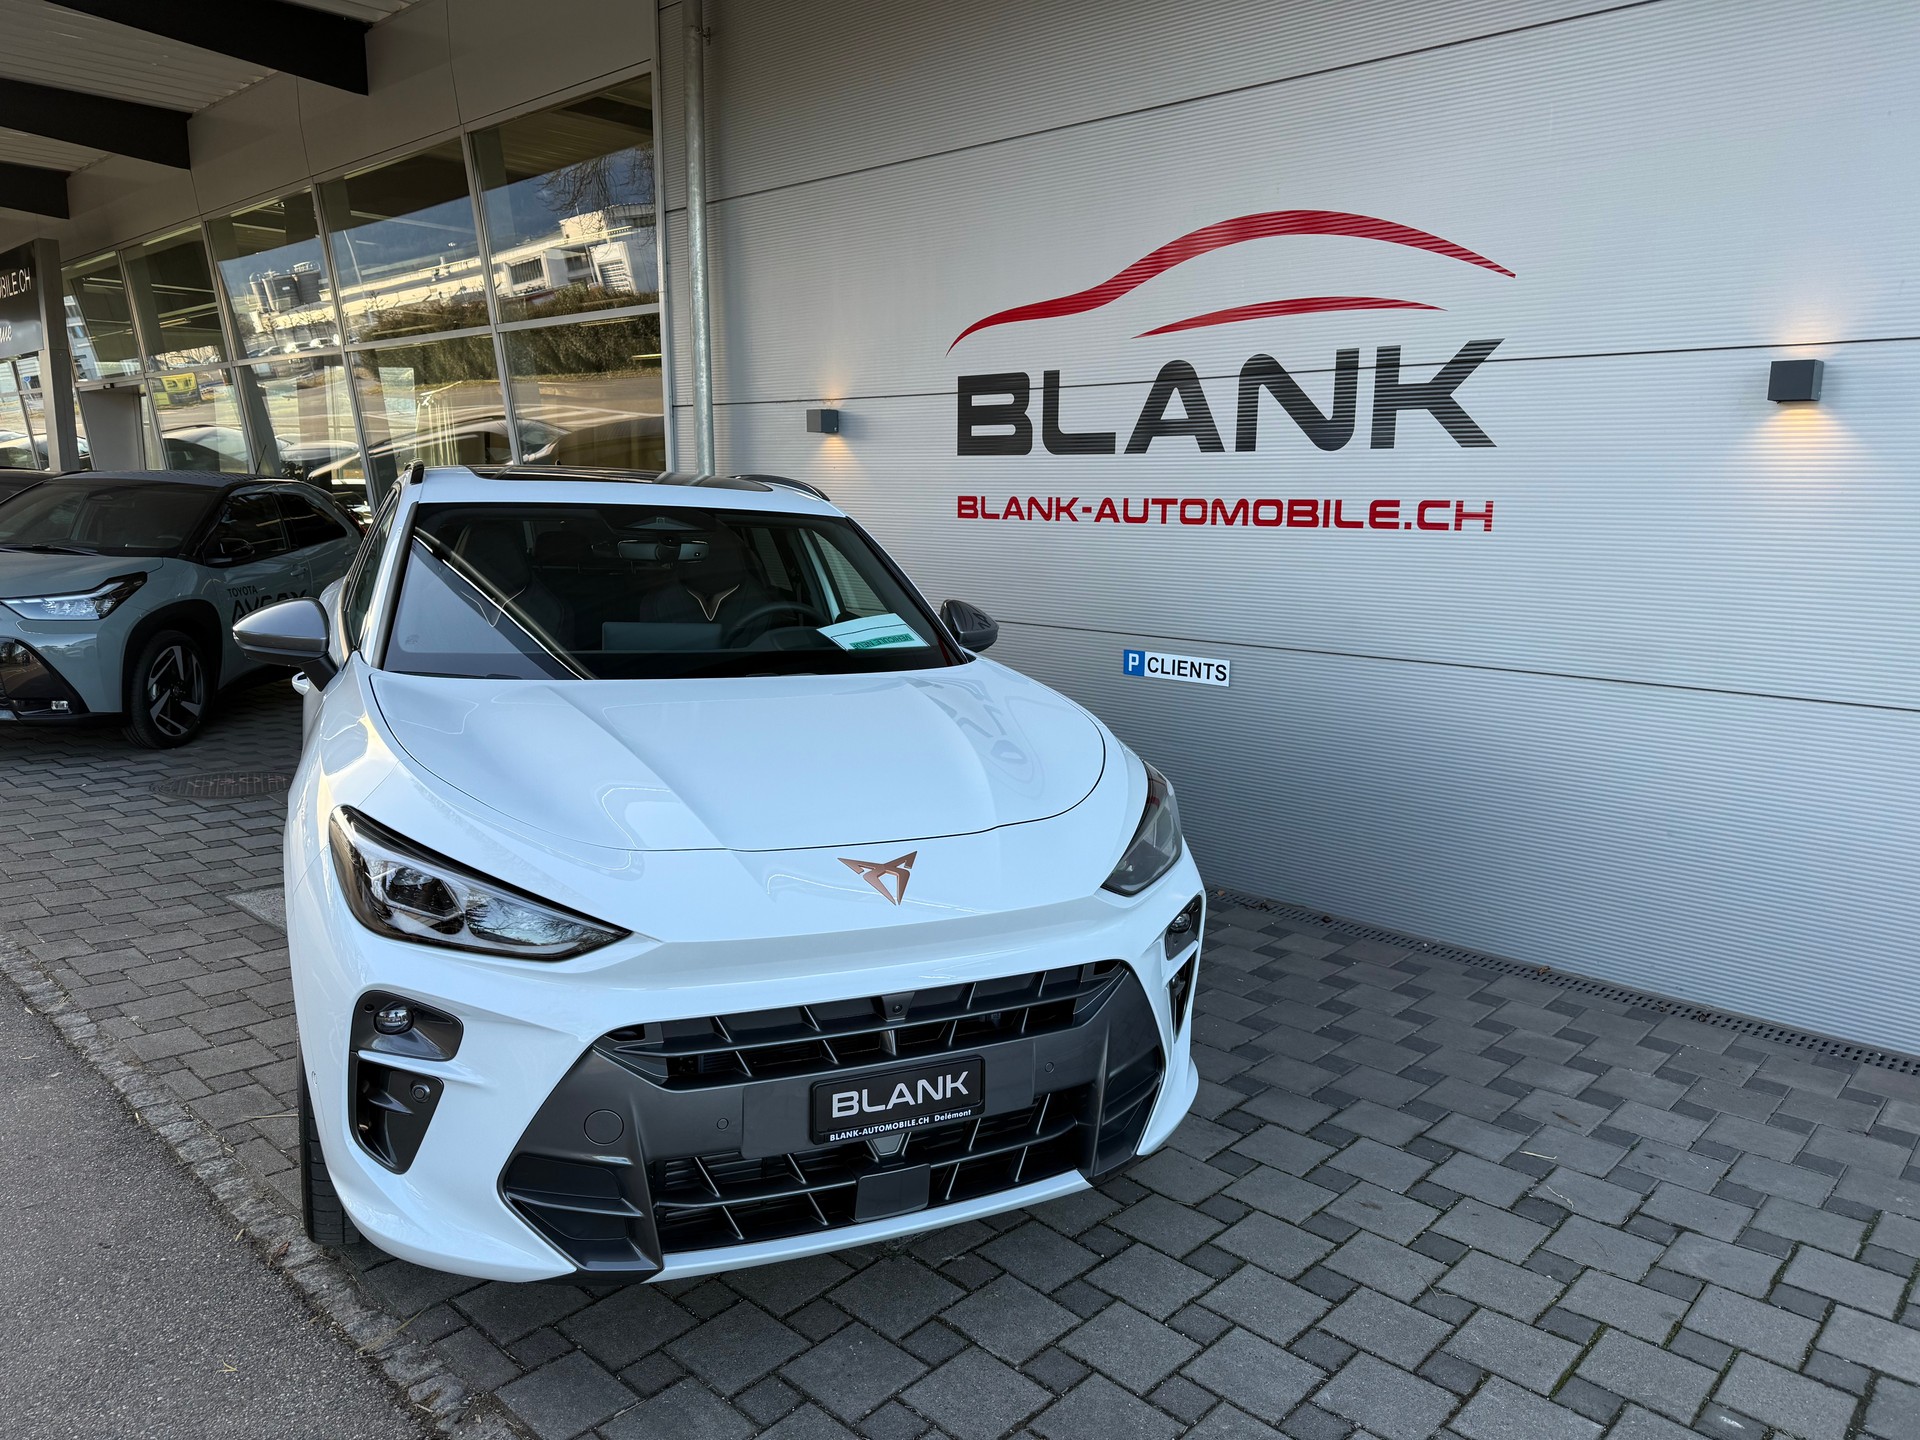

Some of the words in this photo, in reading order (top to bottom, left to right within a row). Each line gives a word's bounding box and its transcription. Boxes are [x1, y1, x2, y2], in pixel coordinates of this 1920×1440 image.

[0, 267, 31, 298] BILE.CH
[957, 337, 1505, 456] BLANK
[957, 495, 1494, 532] BLANK-AUTOMOBILE.CH
[227, 585, 258, 598] TOYOTA
[1128, 652, 1140, 672] P
[1147, 656, 1227, 682] CLIENTS
[832, 1071, 969, 1118] BLANK
[829, 1116, 930, 1142] BLANK-AUTOMOBILE.CH
[934, 1109, 972, 1122] Delémont
